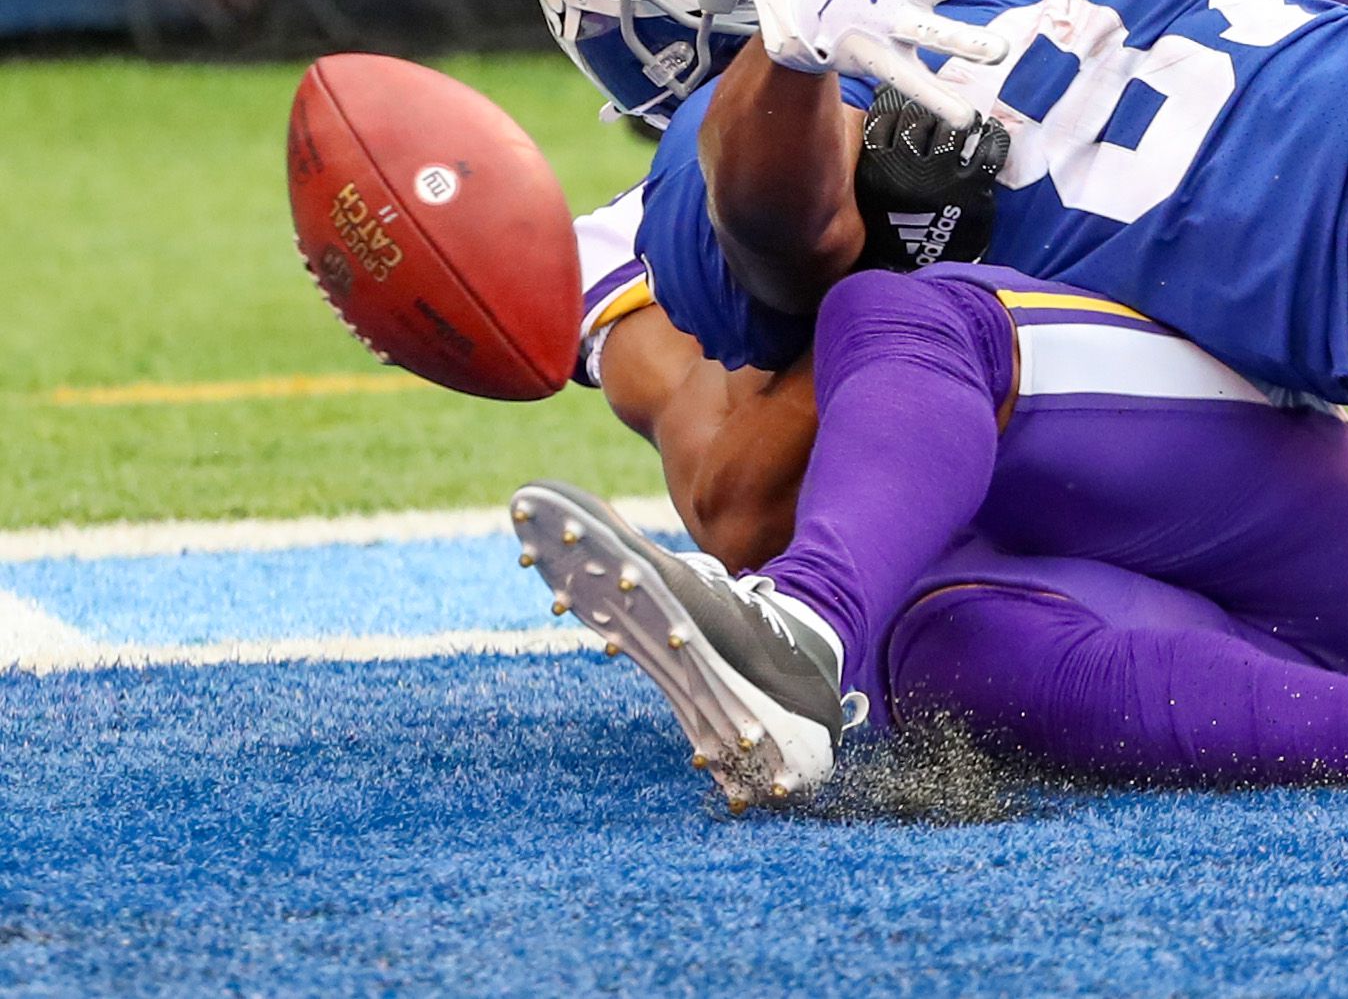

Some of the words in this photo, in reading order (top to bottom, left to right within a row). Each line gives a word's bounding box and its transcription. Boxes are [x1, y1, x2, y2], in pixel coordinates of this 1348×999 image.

[329, 198, 388, 282] CRUCIAL
[338, 181, 404, 269] CATCH
[915, 204, 962, 266] adidas
